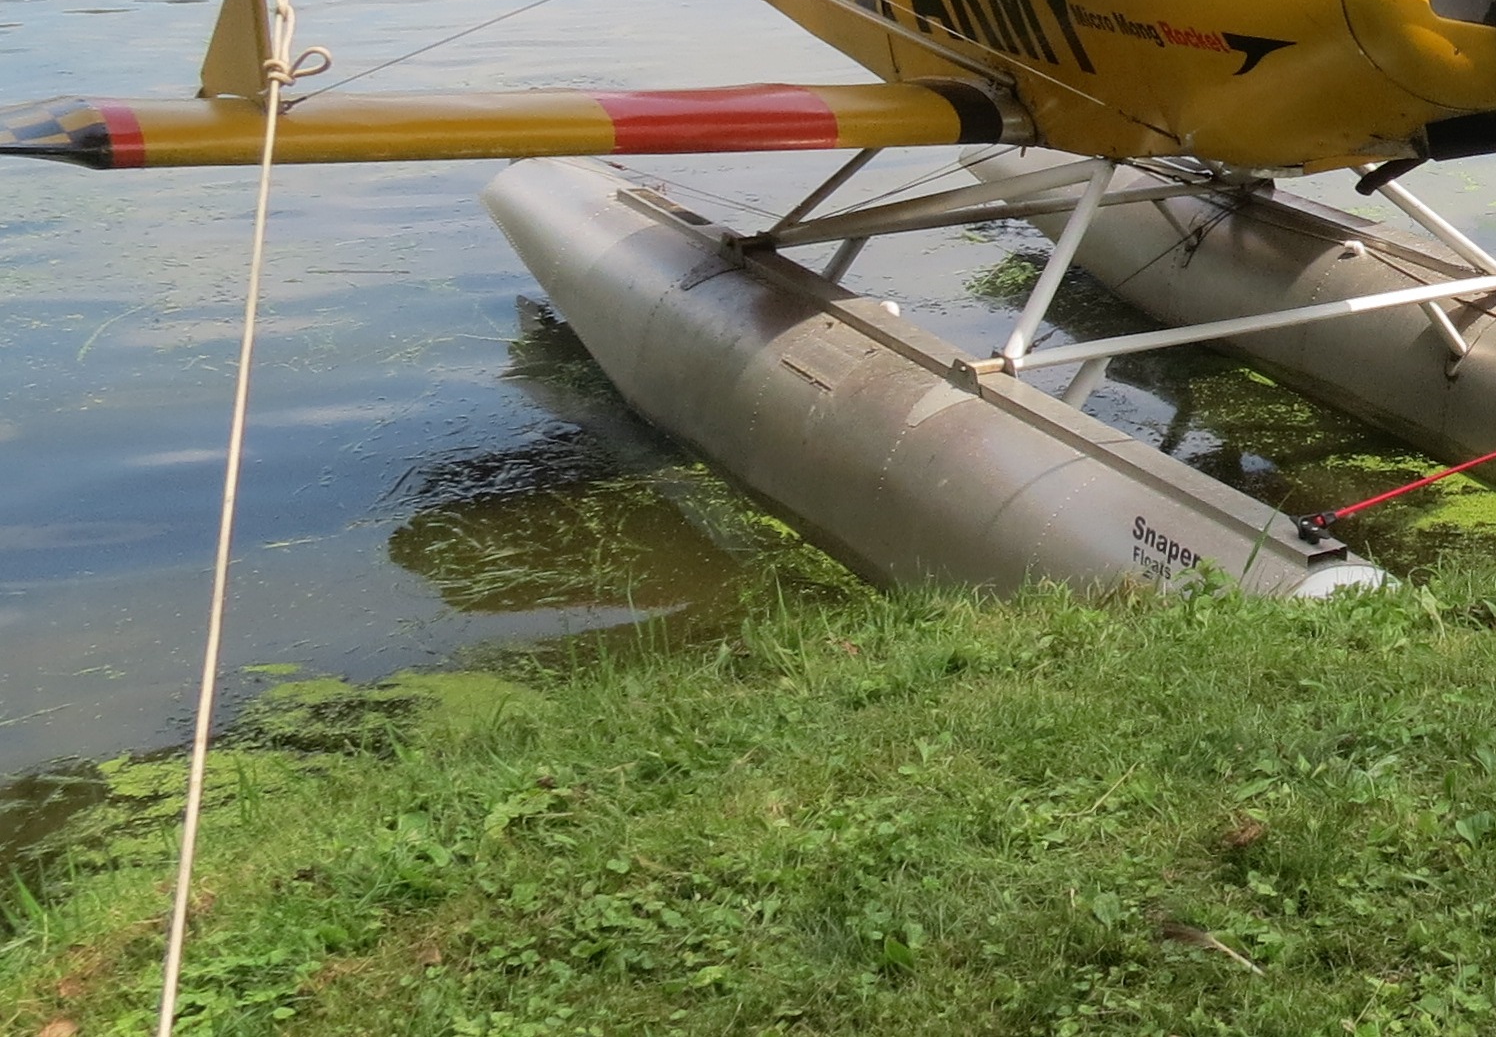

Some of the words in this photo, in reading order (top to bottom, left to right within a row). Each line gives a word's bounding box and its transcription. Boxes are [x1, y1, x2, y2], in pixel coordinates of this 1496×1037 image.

[1070, 4, 1115, 33] Micro
[1112, 12, 1165, 48] Mong
[1157, 20, 1231, 54] Rocket
[1132, 515, 1202, 569] Snaper
[1133, 545, 1172, 581] Floats
